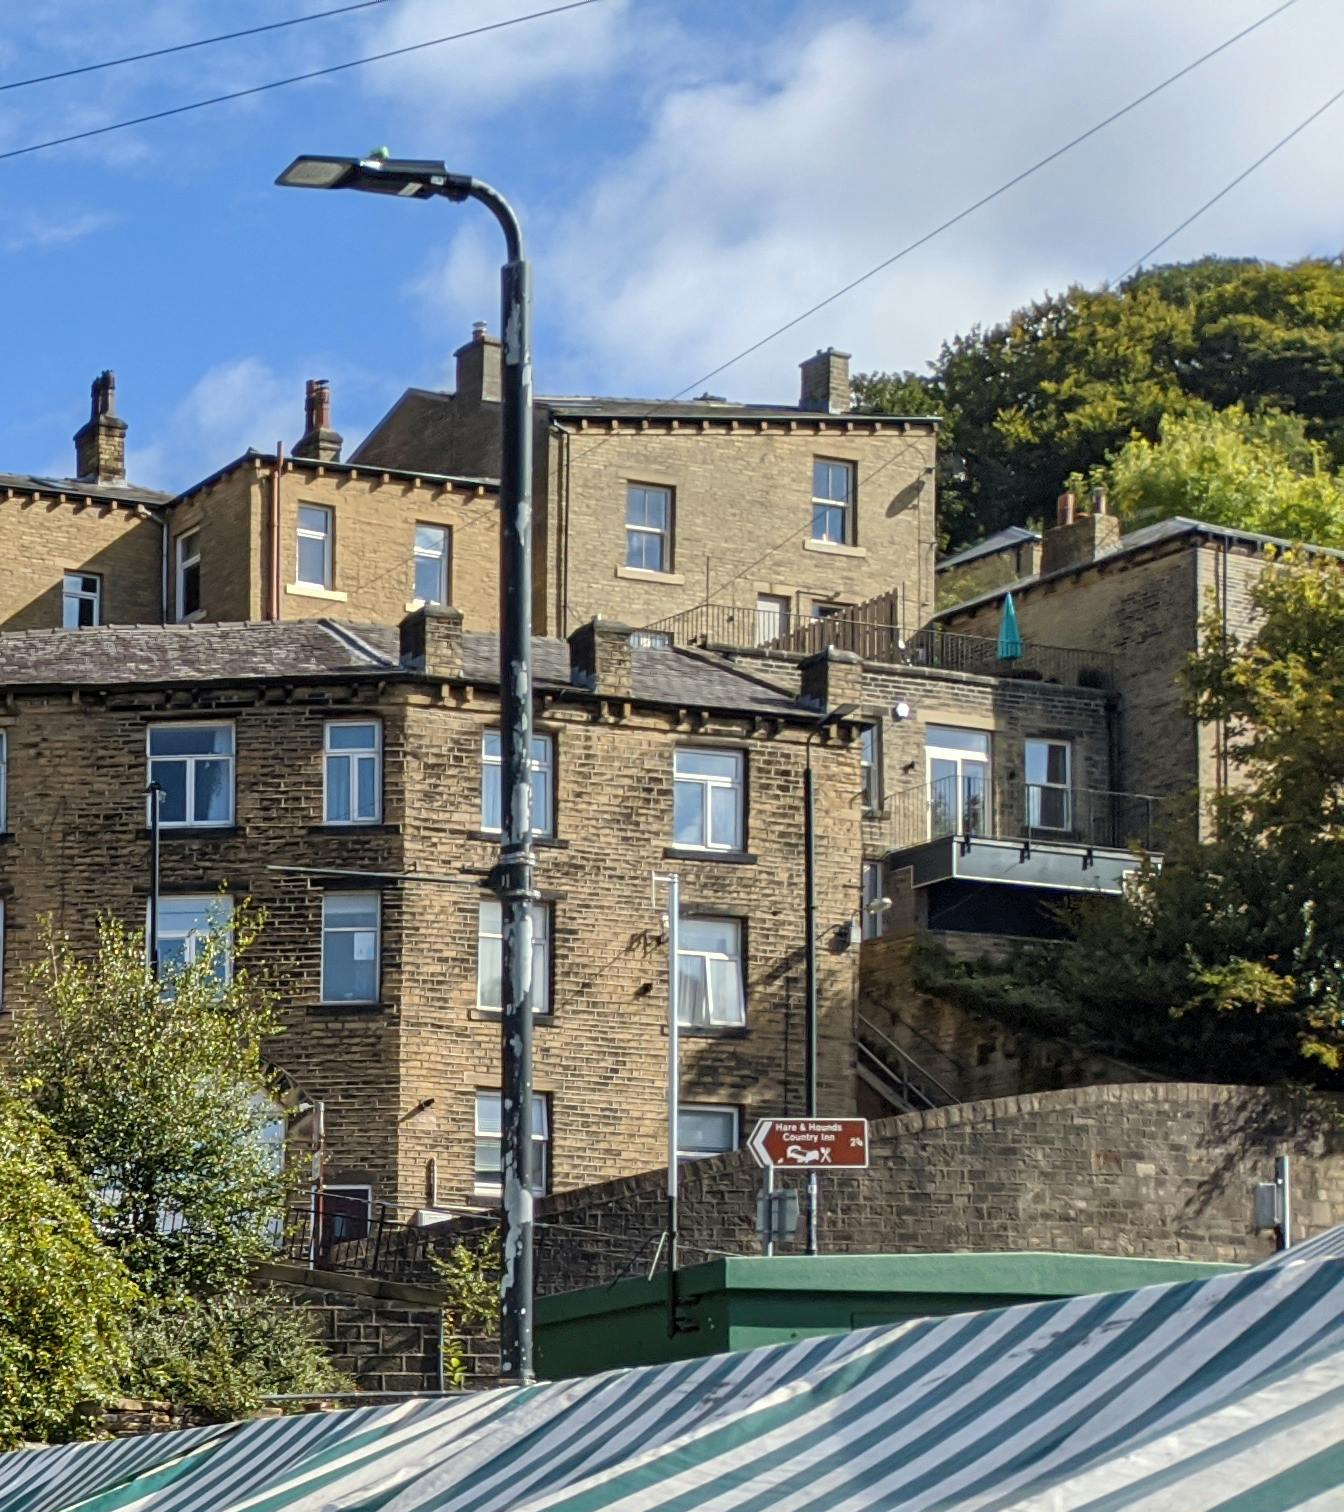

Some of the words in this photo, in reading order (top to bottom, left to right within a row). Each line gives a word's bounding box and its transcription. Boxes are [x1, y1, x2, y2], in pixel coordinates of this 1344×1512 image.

[775, 1123, 797, 1132] Hare
[799, 1123, 807, 1132] &
[808, 1123, 843, 1132] Hounds
[782, 1133, 818, 1143] Country
[821, 1133, 835, 1141] Inn
